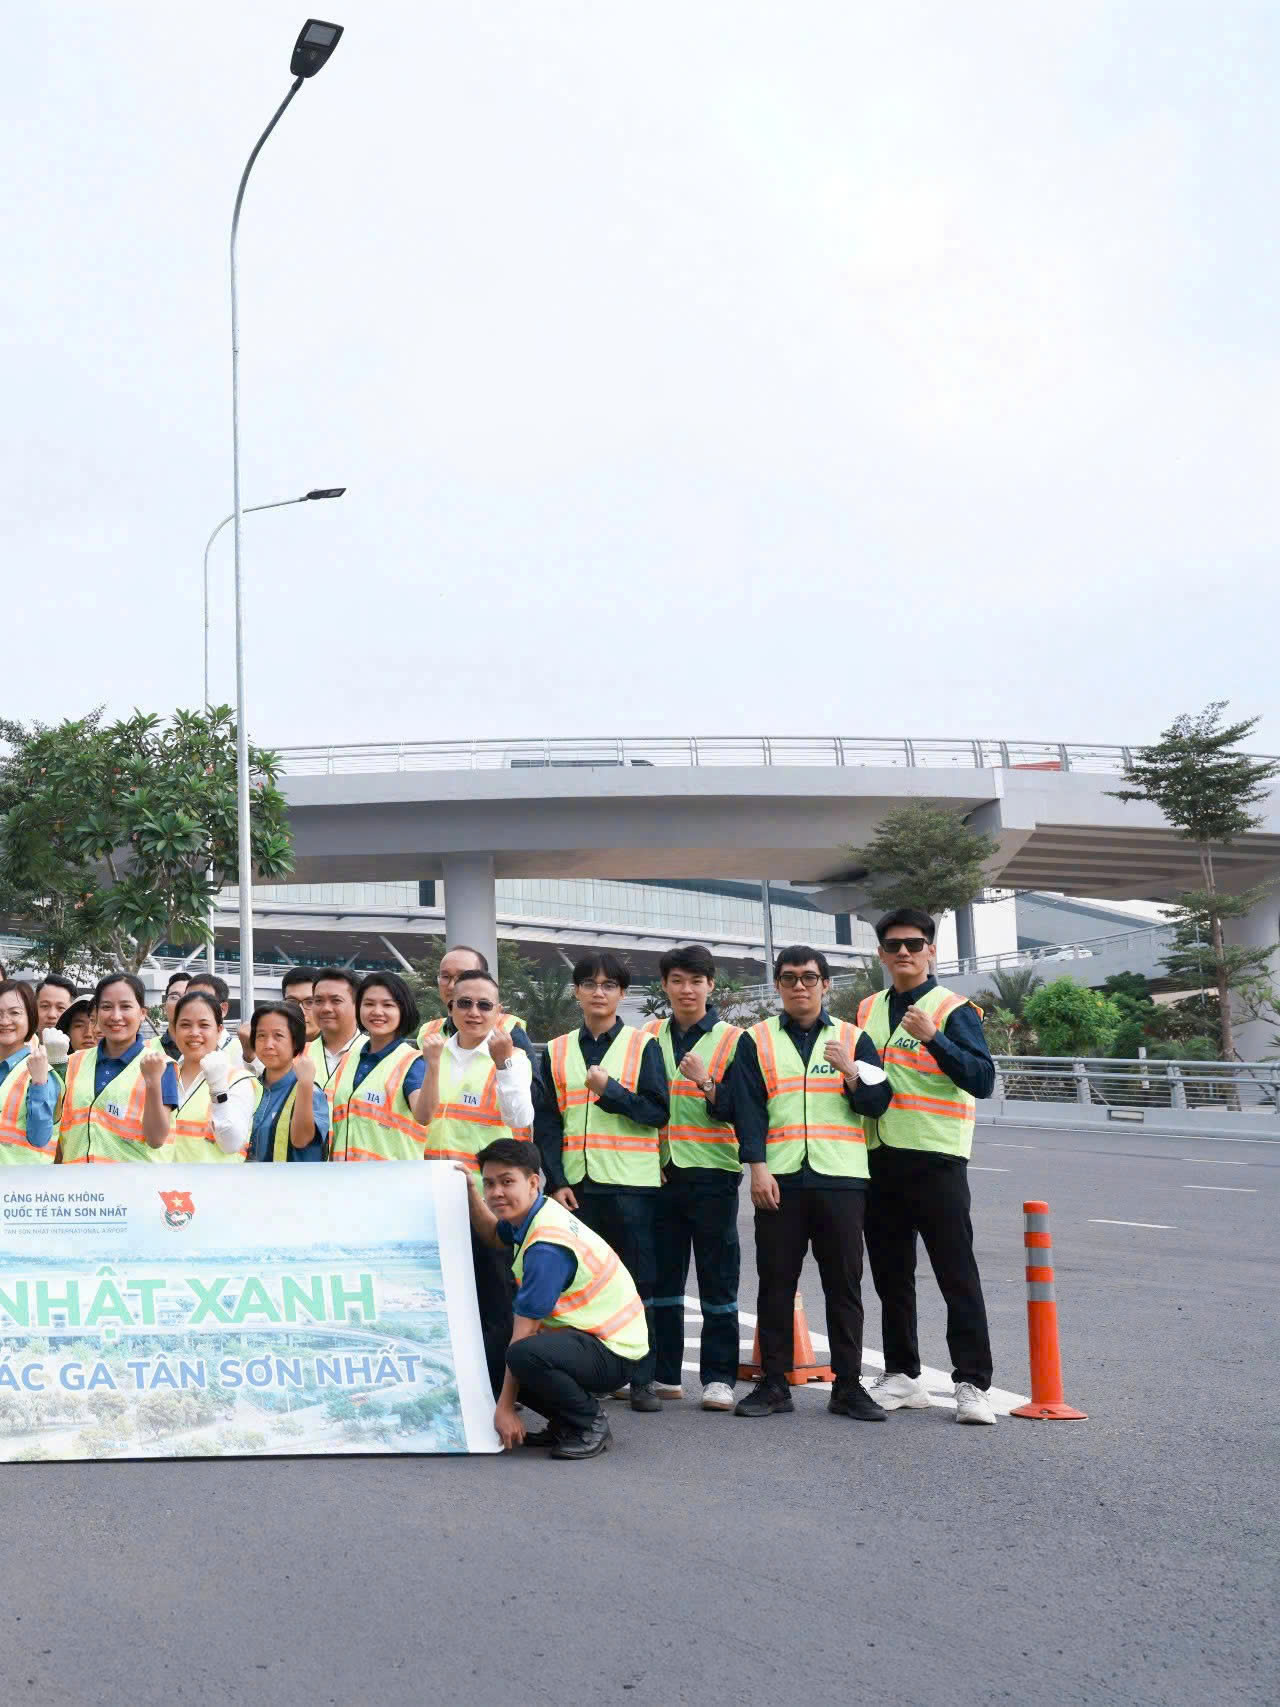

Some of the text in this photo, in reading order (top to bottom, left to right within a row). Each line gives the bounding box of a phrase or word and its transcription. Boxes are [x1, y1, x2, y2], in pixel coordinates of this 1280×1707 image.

[895, 1036, 920, 1050] ACV
[367, 1092, 381, 1104] TIA
[463, 1094, 478, 1105] TIA
[68, 1191, 106, 1203] KHÔNG
[3, 1203, 128, 1219] QUỐC TẾ TÂN SƠN NHẤT
[184, 1273, 378, 1325] XANH
[59, 1361, 117, 1391] GA
[127, 1353, 206, 1389] TÂN
[220, 1357, 305, 1387] SƠN
[316, 1343, 422, 1386] NHẤT
